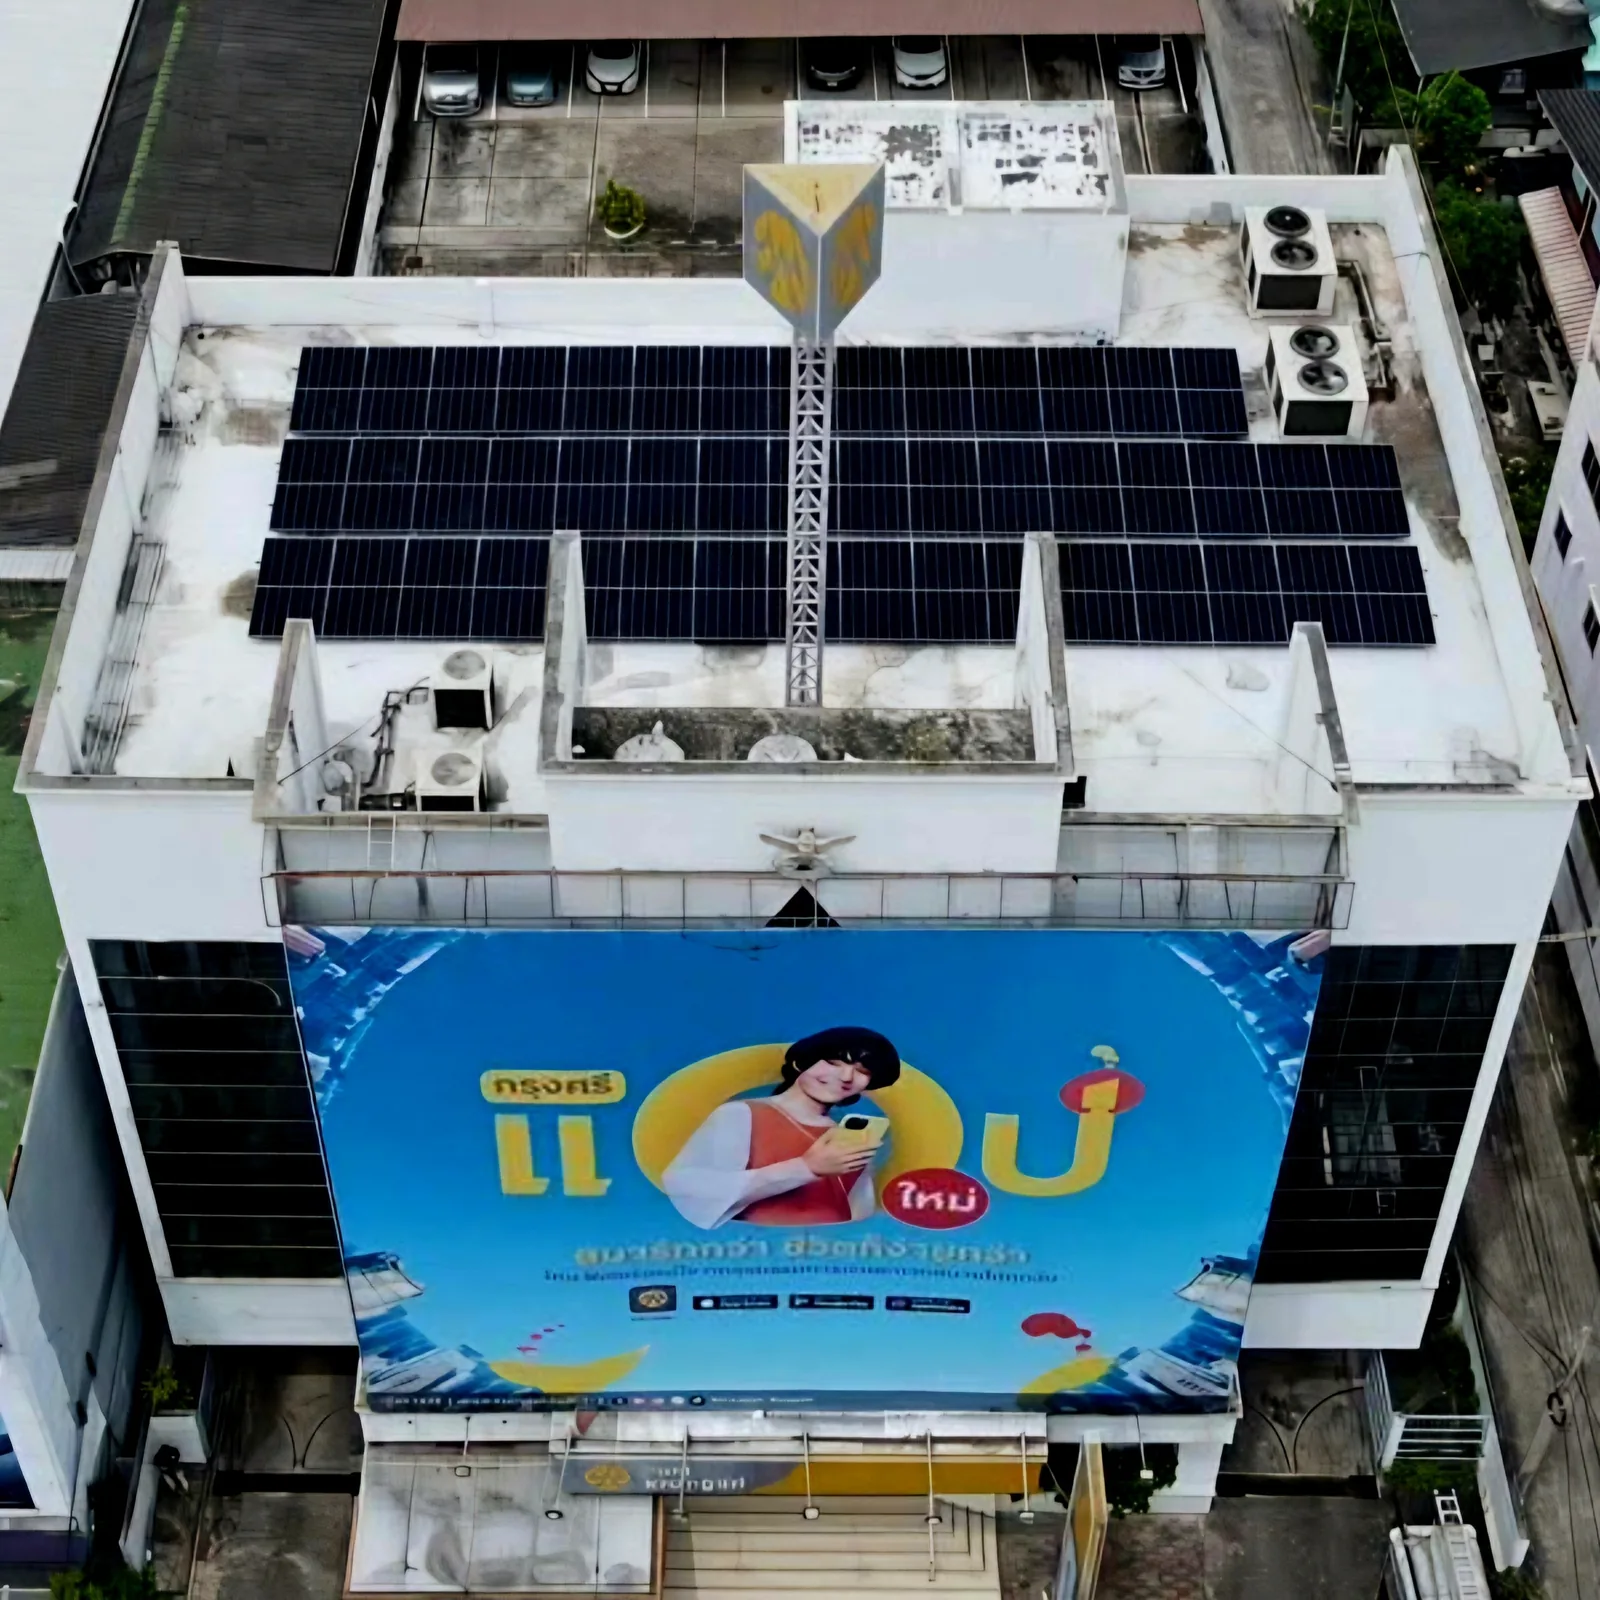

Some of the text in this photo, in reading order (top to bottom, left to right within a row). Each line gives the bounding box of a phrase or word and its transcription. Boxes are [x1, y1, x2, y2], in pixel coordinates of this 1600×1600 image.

[494, 1073, 613, 1099] กรุงศรี
[897, 1181, 977, 1213] ใหม่
